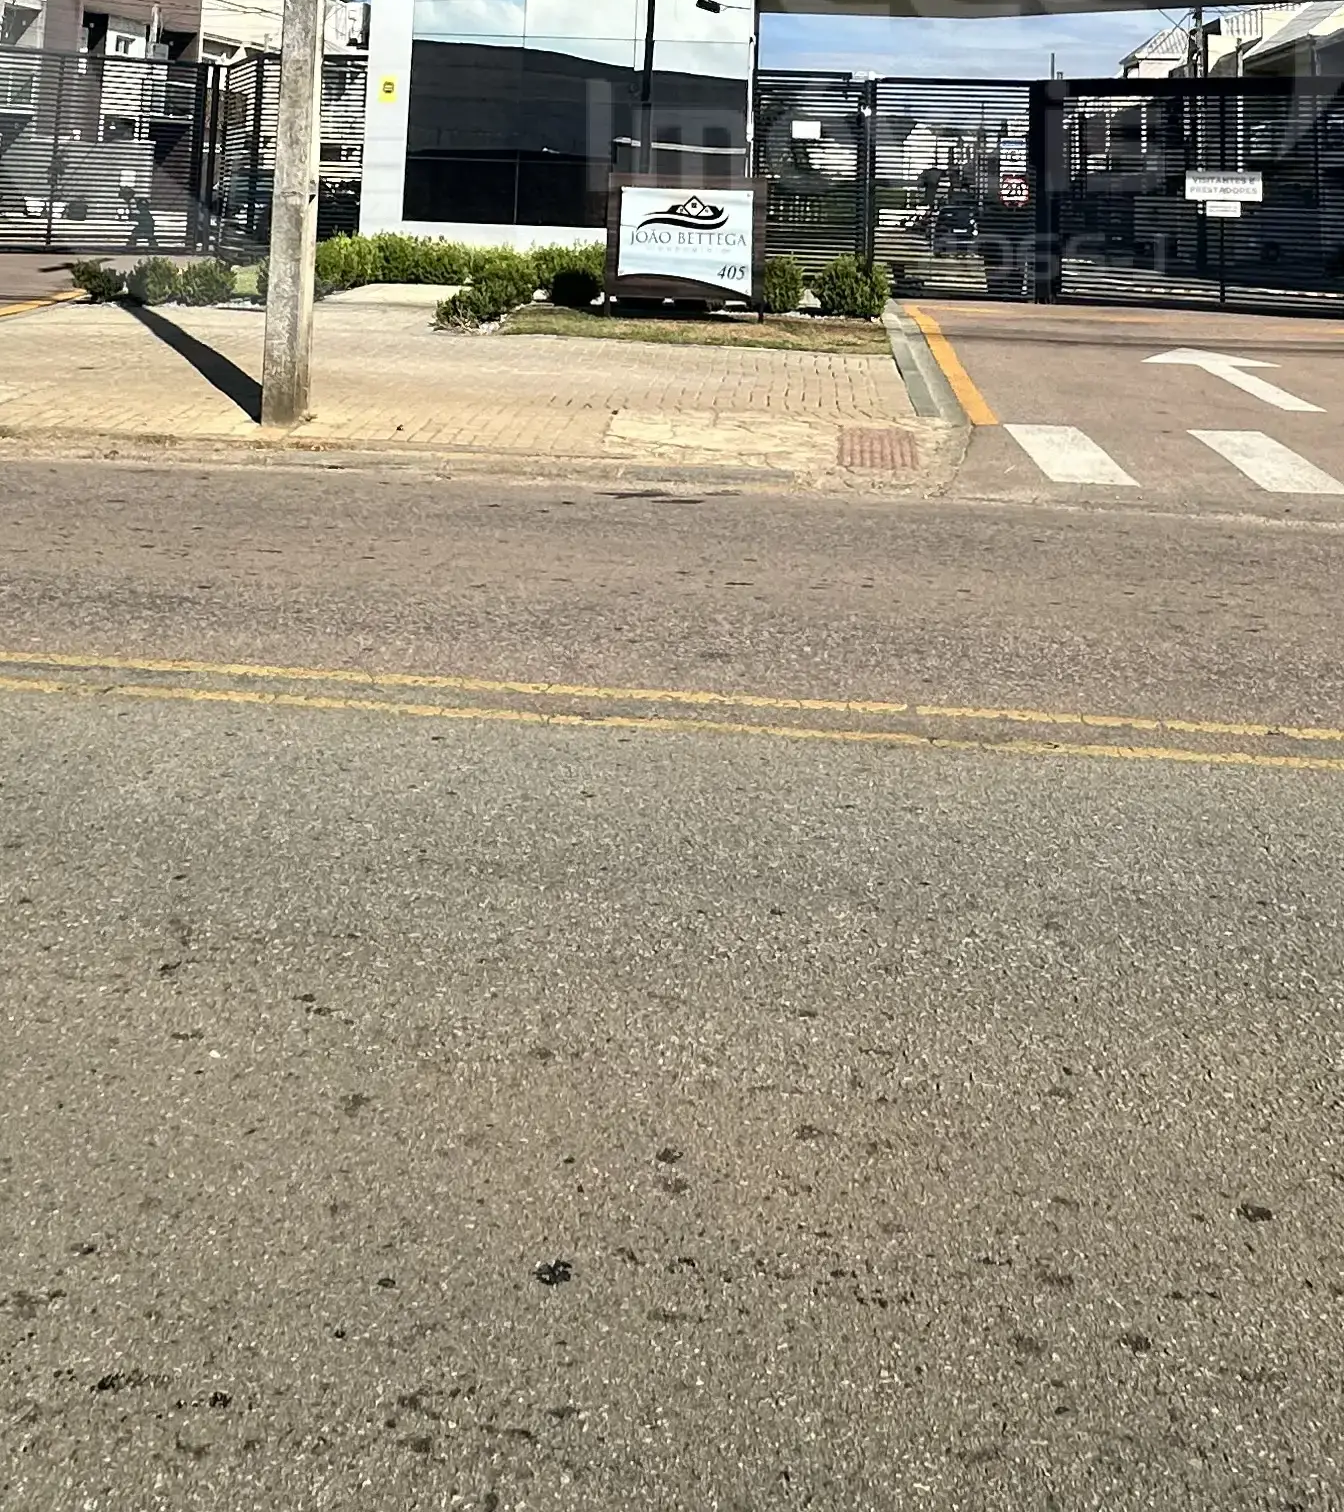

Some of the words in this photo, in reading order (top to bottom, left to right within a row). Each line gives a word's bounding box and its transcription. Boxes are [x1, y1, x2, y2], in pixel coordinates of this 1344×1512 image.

[1190, 186, 1257, 195] PRESTADORES
[630, 229, 672, 245] JOÃO
[678, 232, 747, 247] BETTEGA
[717, 265, 746, 281] 405
